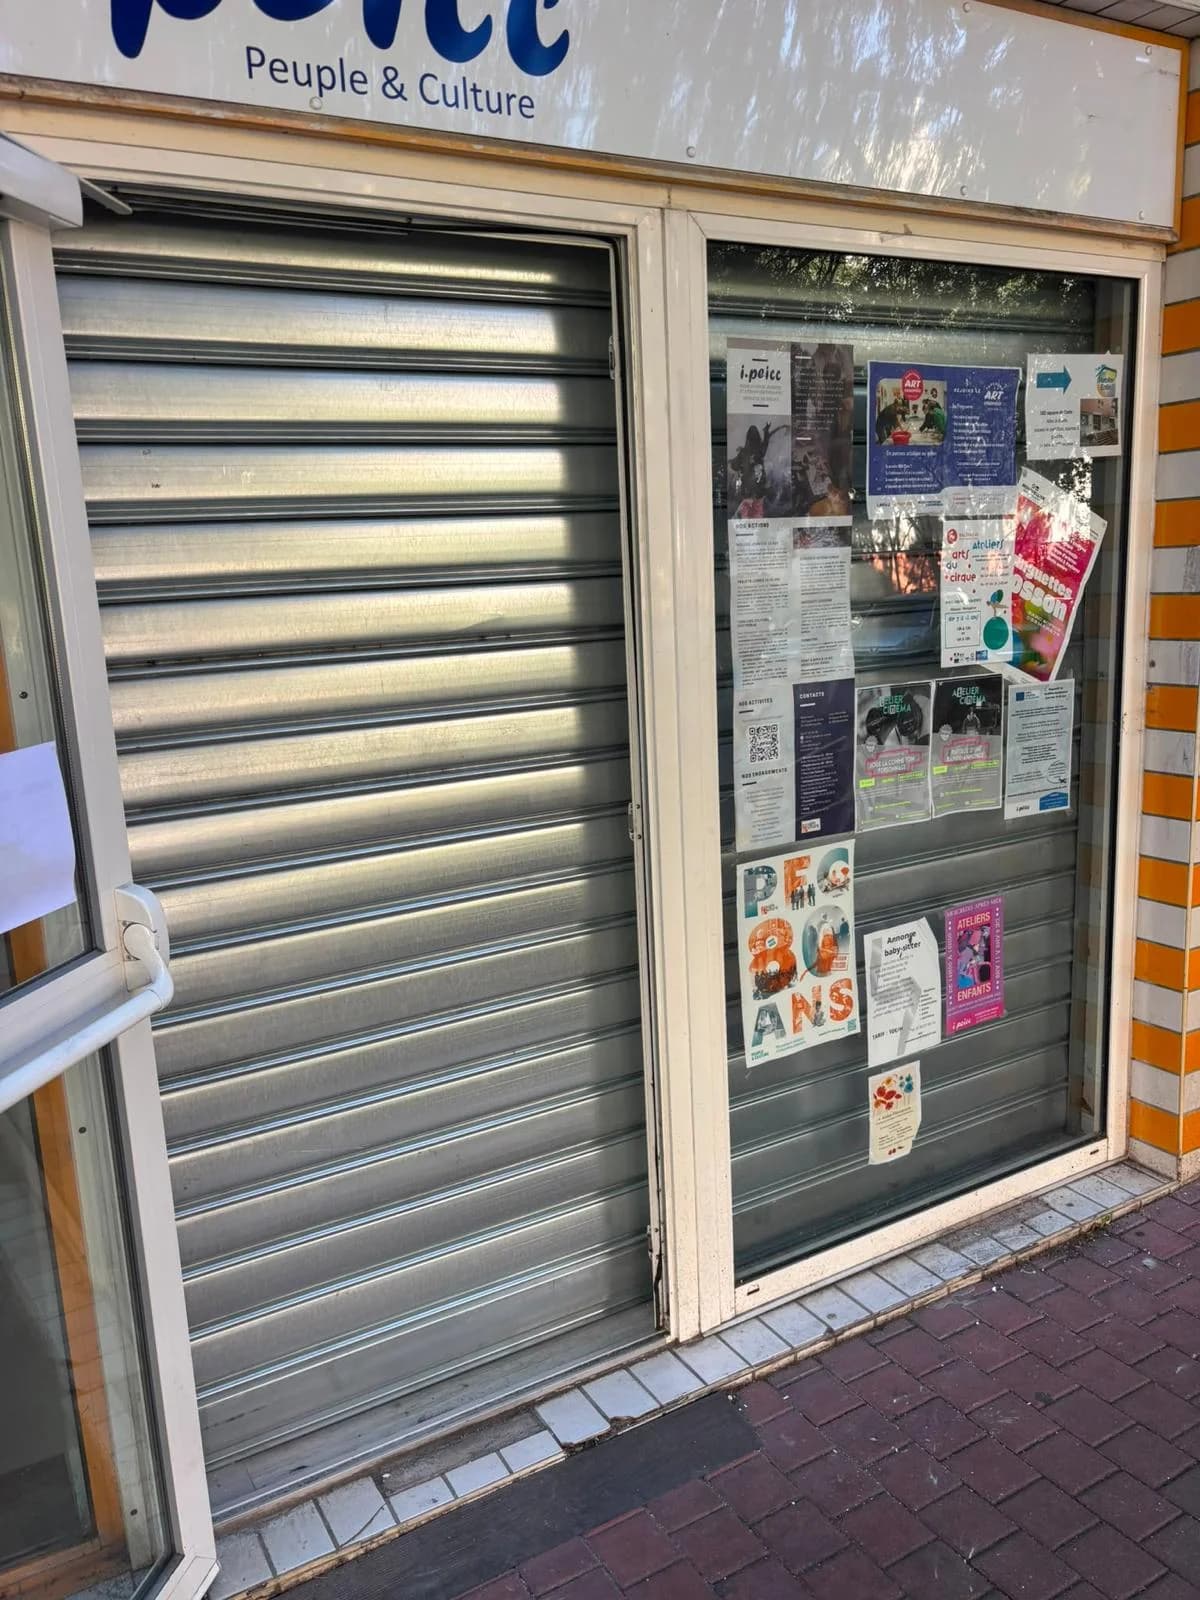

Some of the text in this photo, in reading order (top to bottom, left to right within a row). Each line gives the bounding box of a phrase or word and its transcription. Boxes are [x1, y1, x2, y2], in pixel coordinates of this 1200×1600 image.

[245, 45, 536, 119] Peuple & Culture
[740, 364, 783, 384] i.peicc
[904, 380, 921, 389] ART
[983, 391, 1005, 401] ART
[972, 538, 1004, 551] ateliers
[952, 549, 971, 561] arts
[945, 561, 958, 570] du
[949, 571, 977, 585] cirque
[799, 691, 825, 699] CONTACTS
[957, 911, 991, 930] ATELIERS
[748, 904, 851, 1001] 80
[884, 942, 922, 957] baby-sitter
[957, 982, 992, 1002] ENFANTS
[751, 977, 855, 1048] ANS
